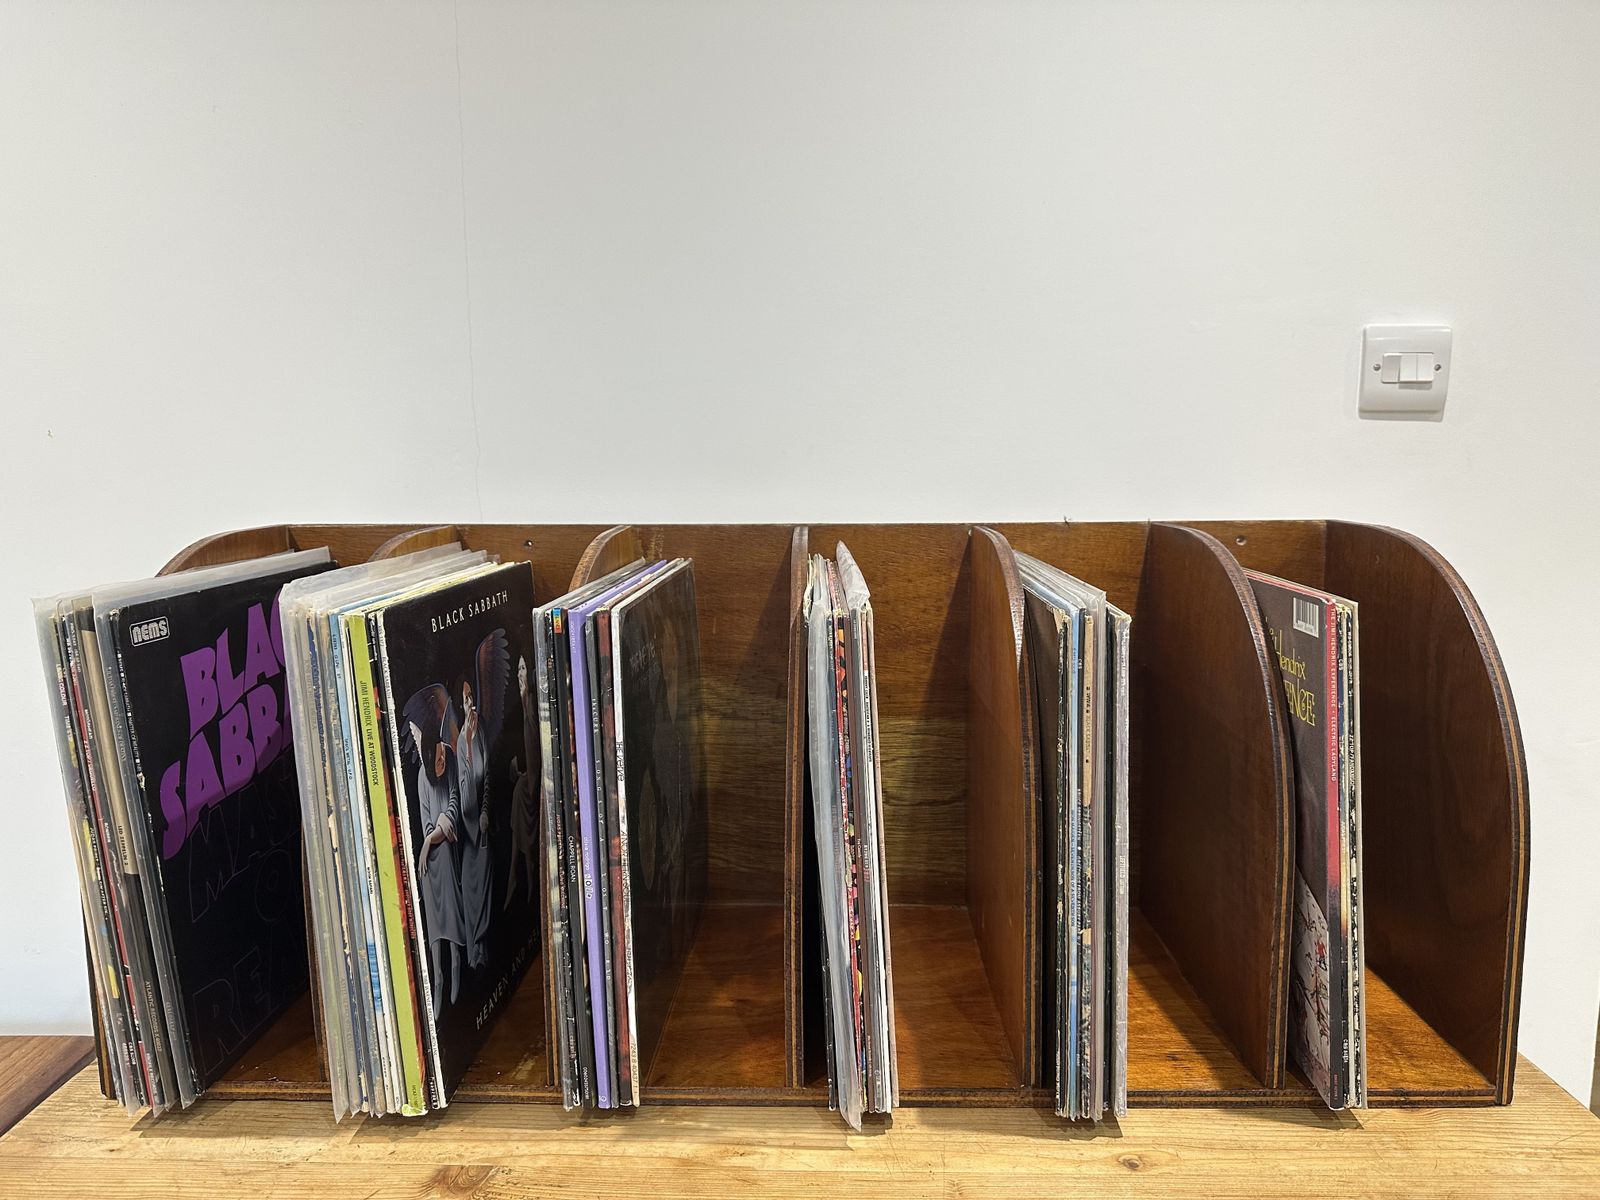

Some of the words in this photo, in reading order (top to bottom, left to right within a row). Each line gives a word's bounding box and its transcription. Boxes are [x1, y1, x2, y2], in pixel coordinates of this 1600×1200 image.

[431, 607, 465, 633] BLACK
[468, 590, 508, 617] SABBATH
[132, 620, 168, 644] NEMS
[58, 682, 67, 706] COLOUR
[359, 680, 367, 695] JIMI
[362, 697, 372, 726] HENDRIX
[367, 741, 374, 749] AT
[369, 750, 379, 785] WOODSTOCK
[119, 836, 127, 860] ZEPPELIN
[144, 980, 154, 1007] ATLANTIC
[149, 1007, 158, 1032] RECORDS
[476, 973, 509, 1030] HEAVEN
